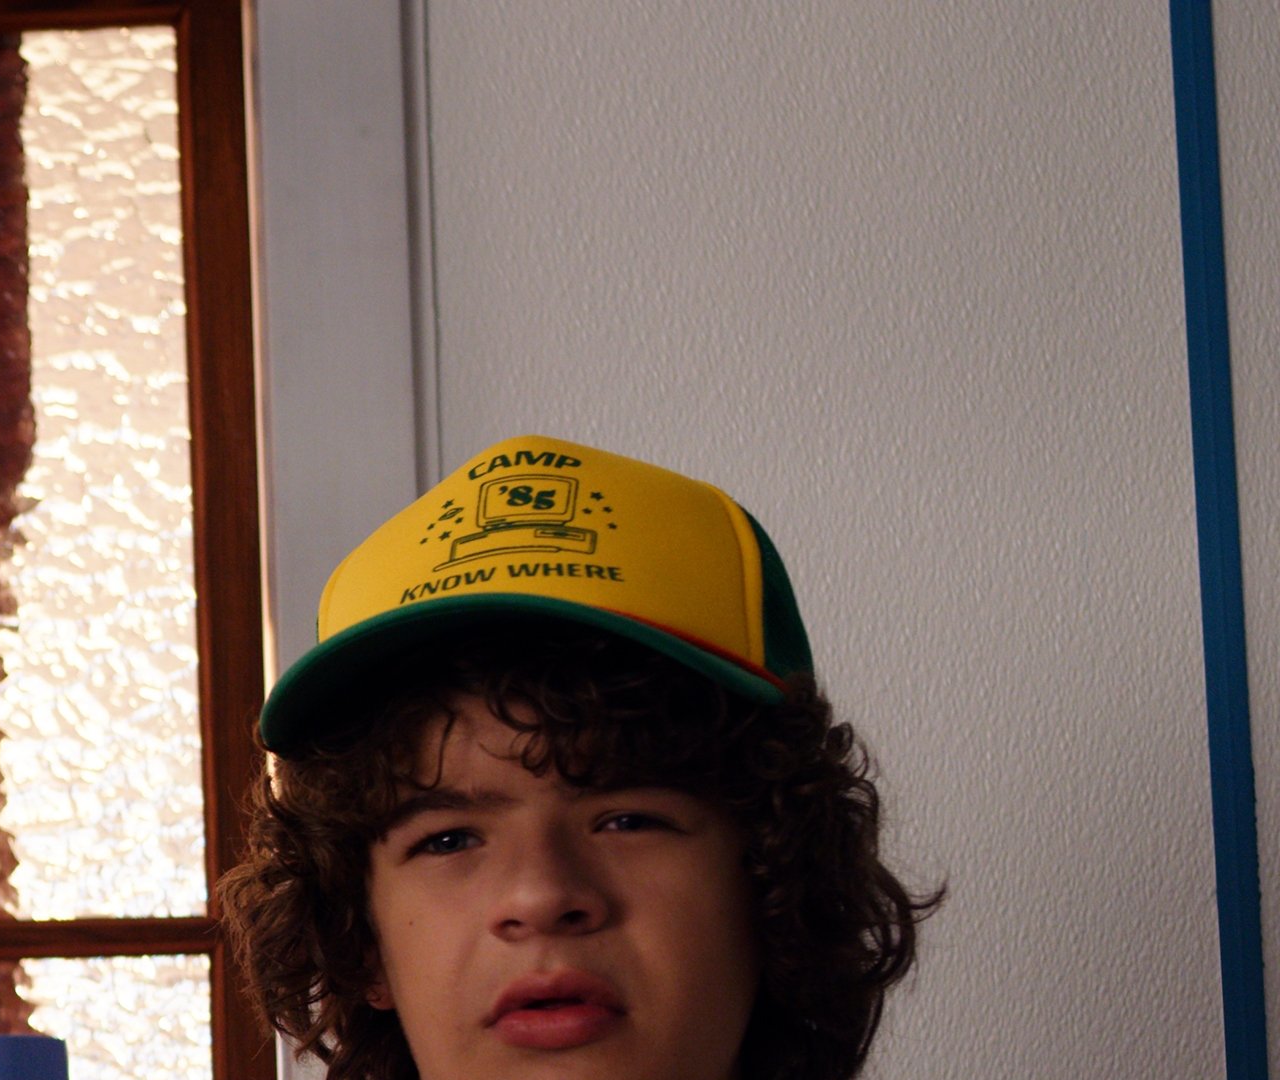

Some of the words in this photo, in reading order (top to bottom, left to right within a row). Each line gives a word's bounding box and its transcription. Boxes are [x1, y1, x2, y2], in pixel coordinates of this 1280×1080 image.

[468, 450, 582, 481] CAMP
[498, 485, 557, 510] '85
[400, 567, 496, 604] KNOW
[507, 562, 625, 582] WHERE
